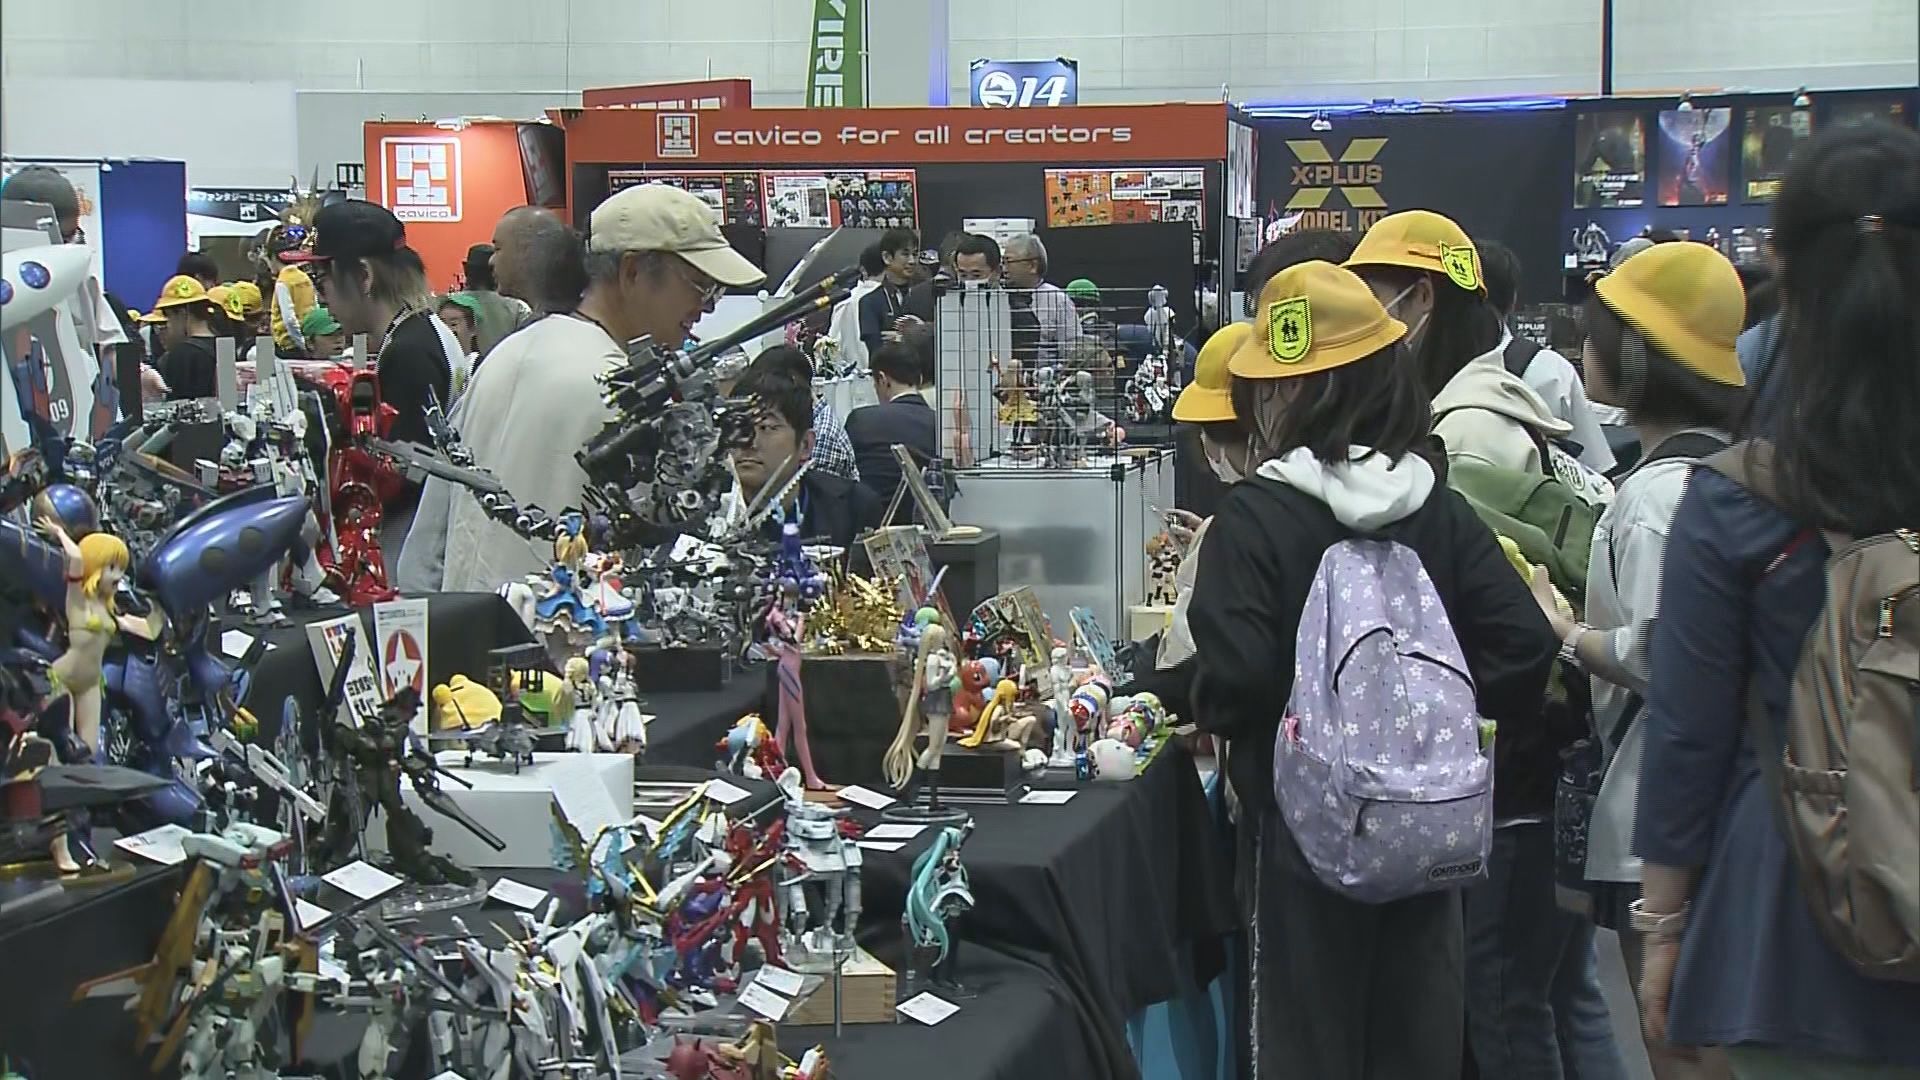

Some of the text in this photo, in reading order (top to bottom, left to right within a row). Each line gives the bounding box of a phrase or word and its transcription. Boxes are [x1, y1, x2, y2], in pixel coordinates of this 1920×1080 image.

[713, 124, 1132, 146] cavico for all creators
[397, 207, 449, 218] cavico
[50, 399, 69, 422] 09
